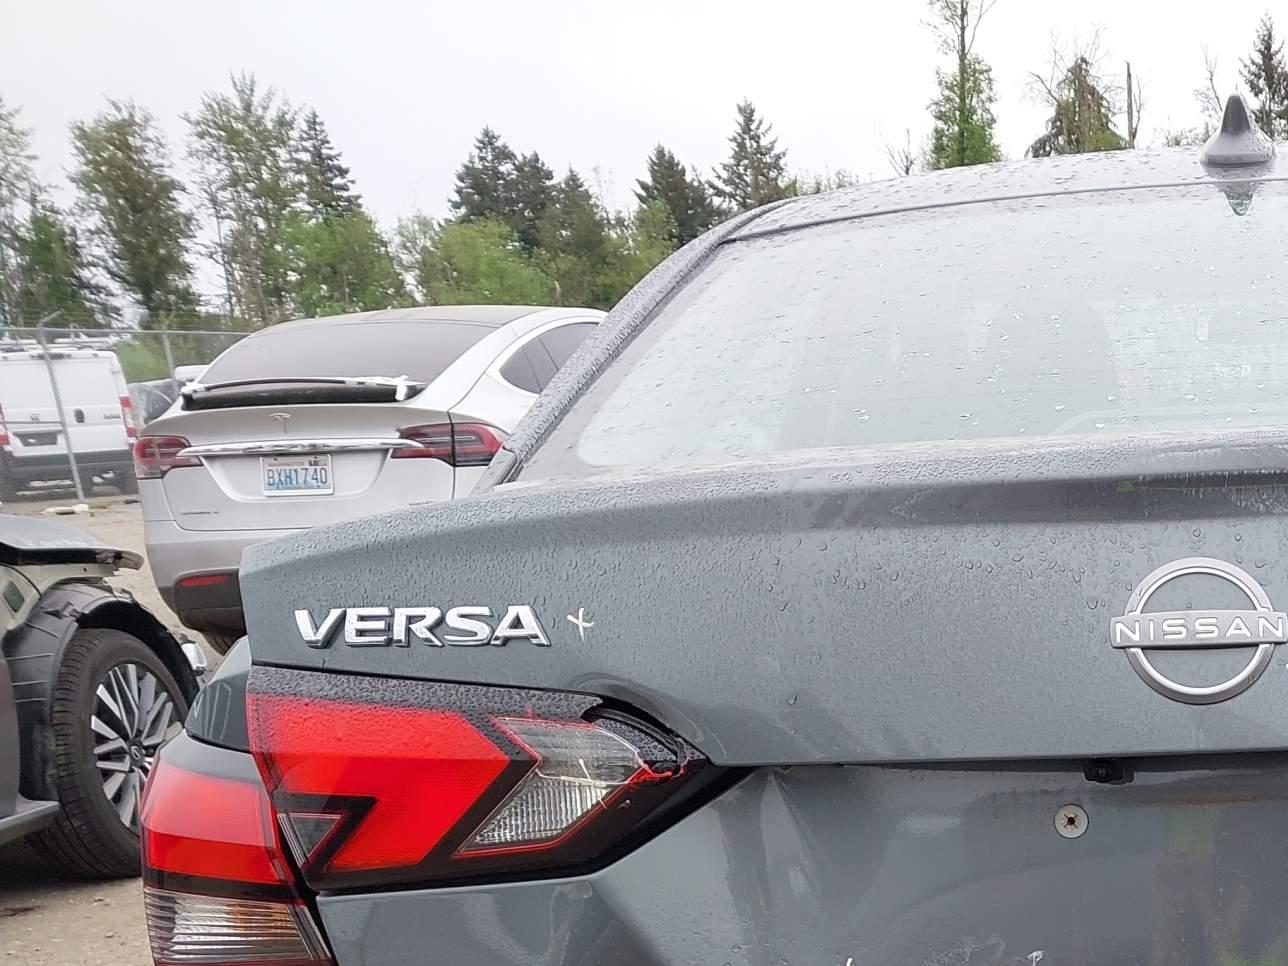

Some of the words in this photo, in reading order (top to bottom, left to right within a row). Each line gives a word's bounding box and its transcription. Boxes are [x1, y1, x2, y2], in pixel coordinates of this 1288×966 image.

[267, 467, 328, 486] BXH1740
[294, 605, 551, 647] VERSA
[1115, 615, 1284, 643] NISSAN
